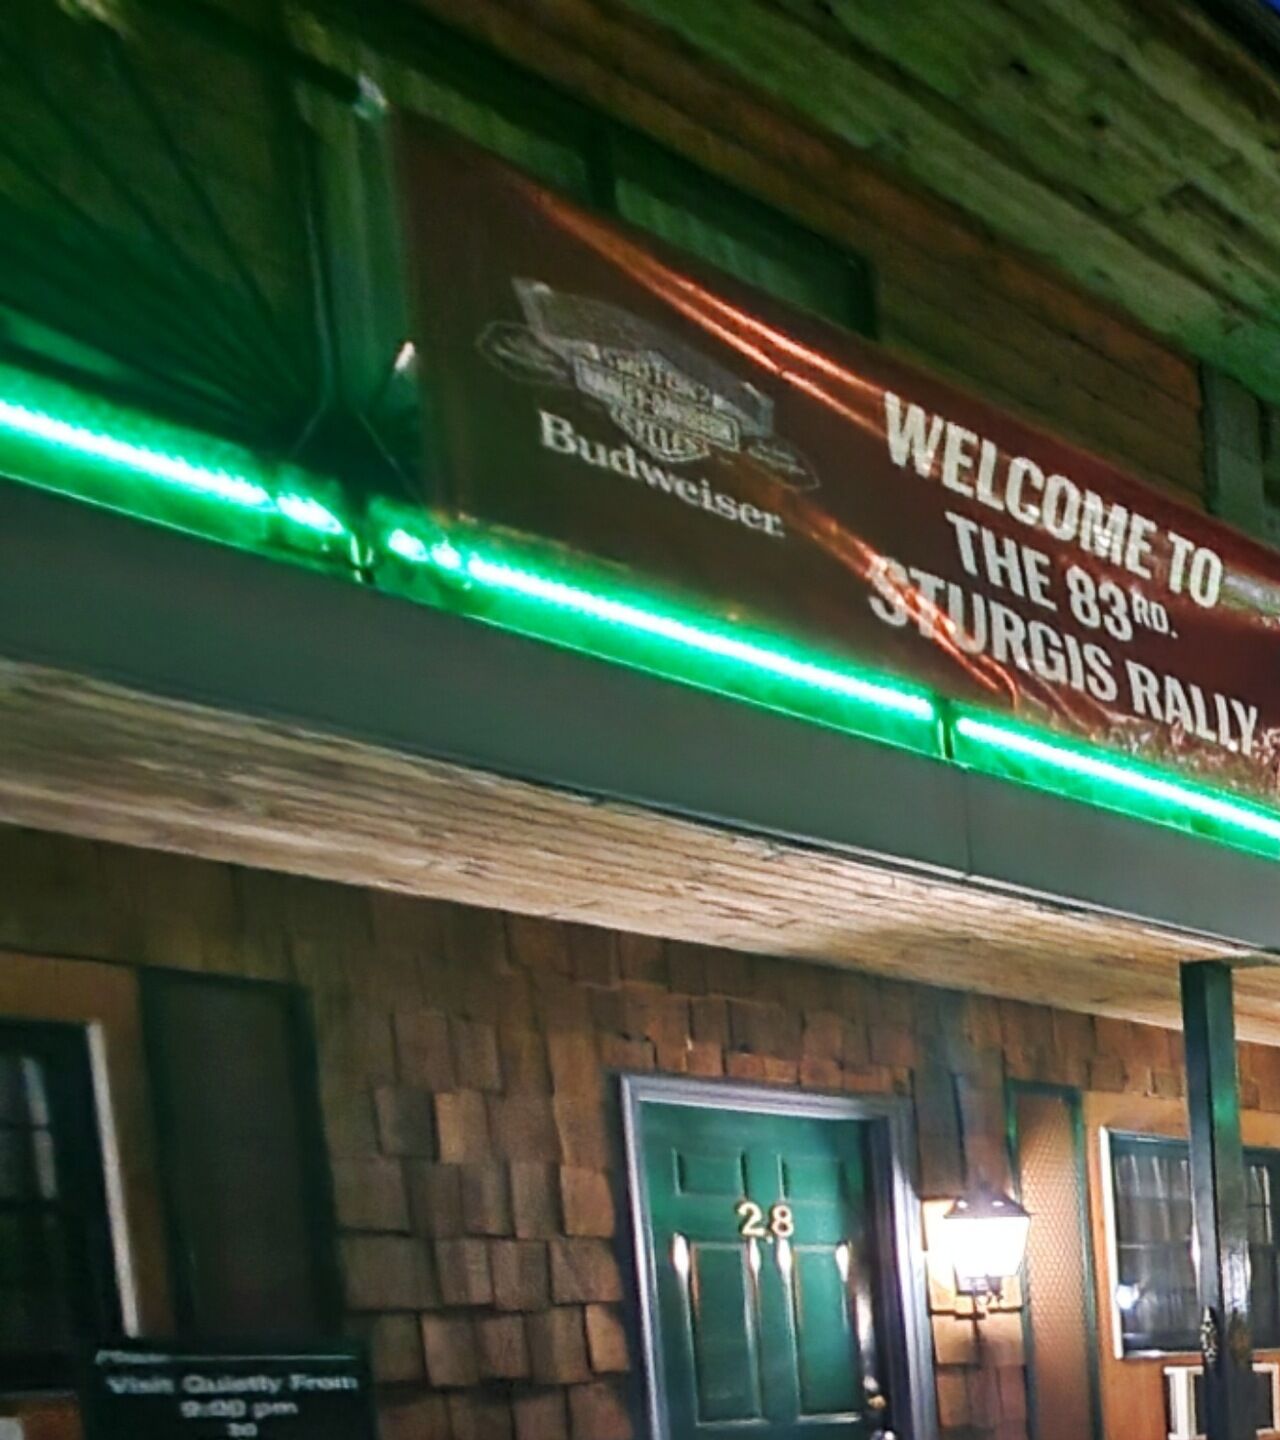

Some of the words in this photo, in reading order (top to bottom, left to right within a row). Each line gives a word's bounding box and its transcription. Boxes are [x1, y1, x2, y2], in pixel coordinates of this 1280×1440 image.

[540, 408, 786, 539] Budweiser
[884, 391, 1158, 582] WELCOME
[1166, 529, 1225, 609] TO
[945, 511, 1057, 612] THE
[867, 556, 1120, 704] STURGIS
[1127, 658, 1260, 756] RALLY
[737, 1201, 794, 1239] 28
[181, 1374, 281, 1394] Quietly
